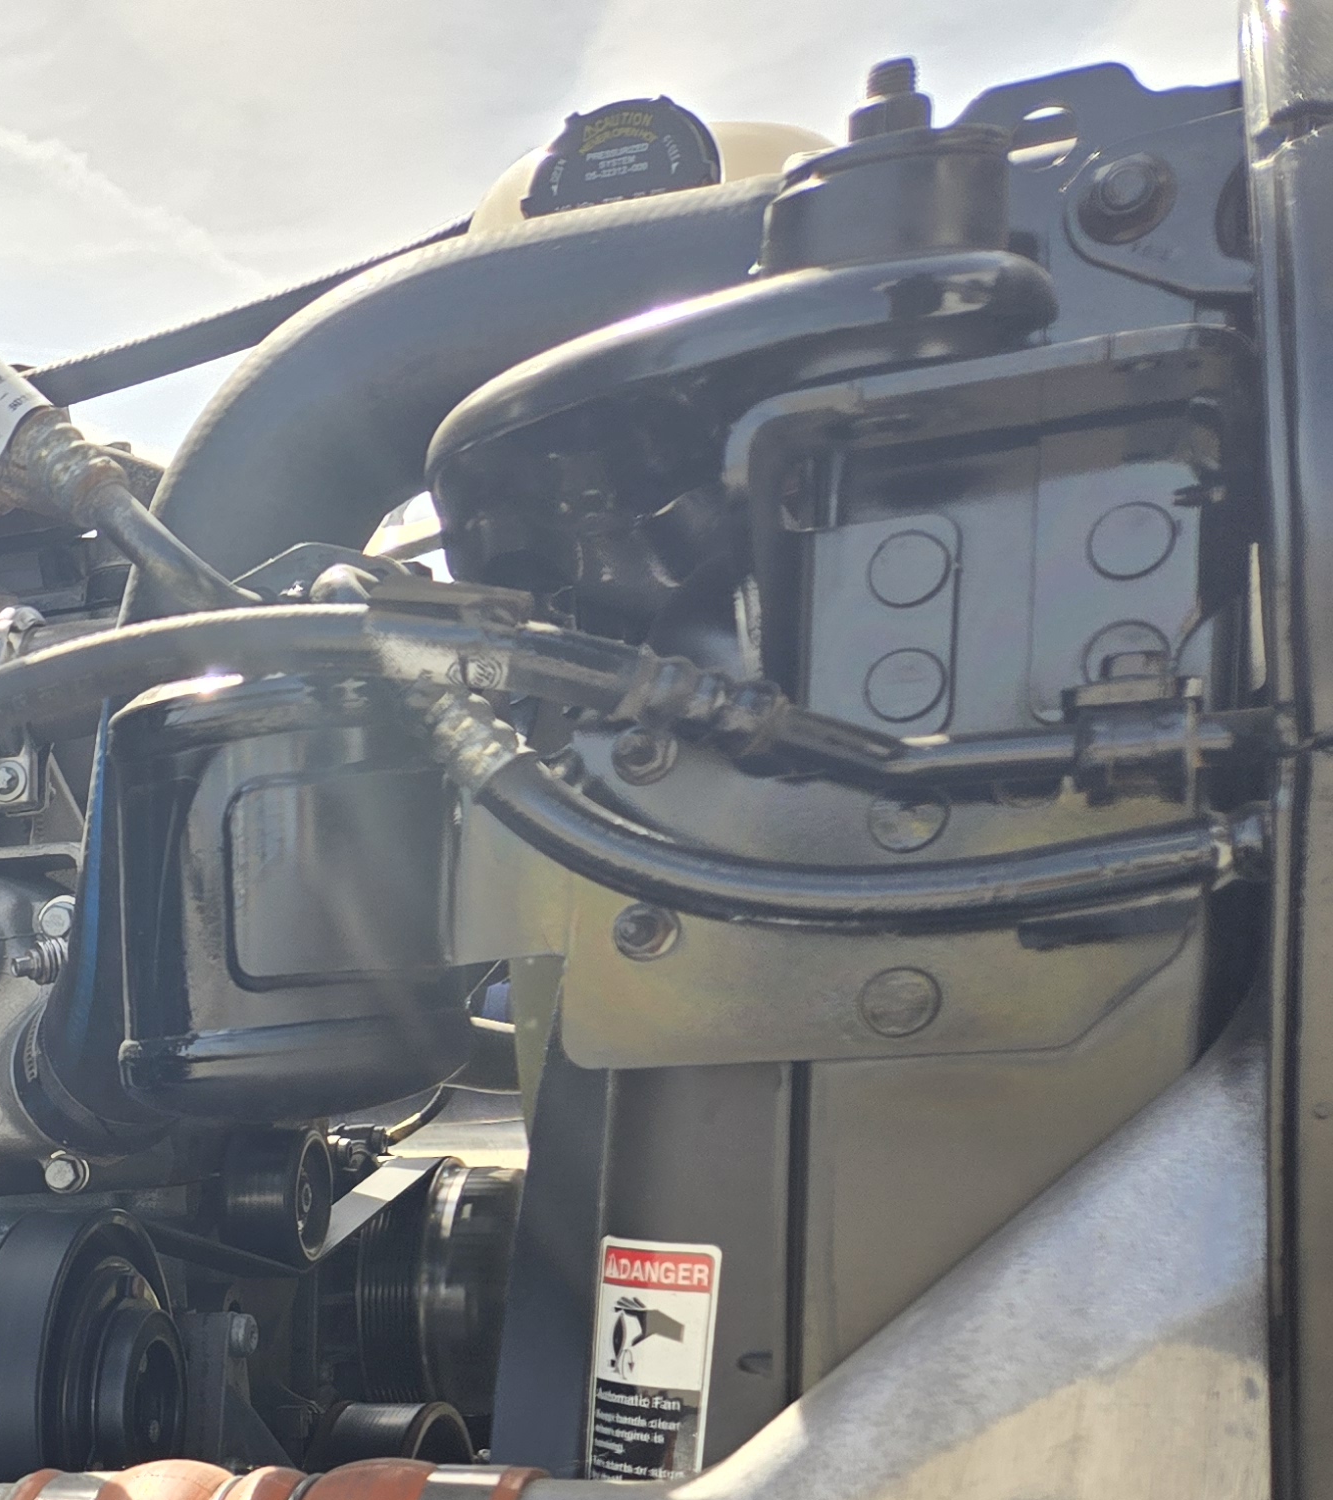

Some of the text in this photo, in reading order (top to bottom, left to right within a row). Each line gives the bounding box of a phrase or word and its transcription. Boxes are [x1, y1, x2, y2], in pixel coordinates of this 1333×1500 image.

[593, 111, 654, 131] CAUTION
[620, 1260, 710, 1287] DANGER
[652, 1396, 681, 1412] Fan
